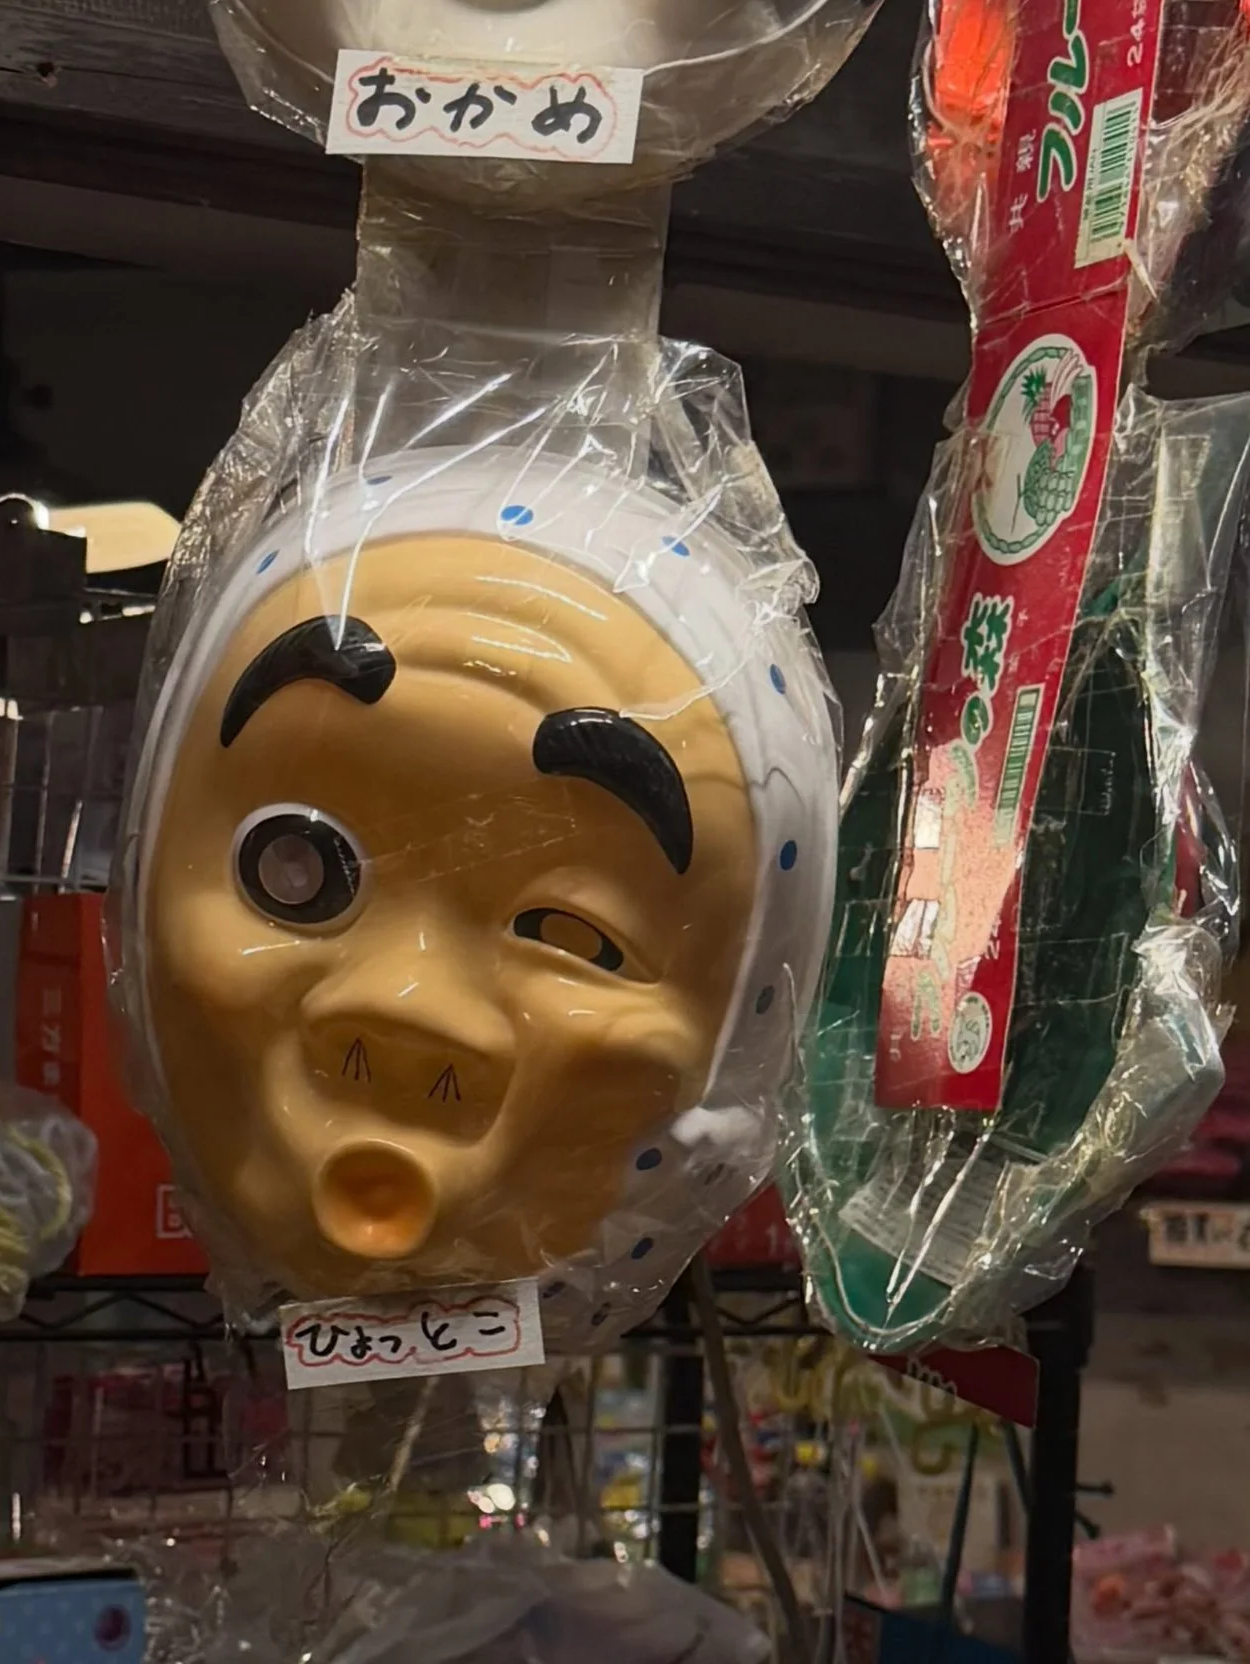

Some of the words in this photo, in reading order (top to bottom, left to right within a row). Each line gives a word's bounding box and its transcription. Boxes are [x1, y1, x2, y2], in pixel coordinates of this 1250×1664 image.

[357, 67, 602, 144] おかめ
[295, 1312, 505, 1359] ひょっとこ
